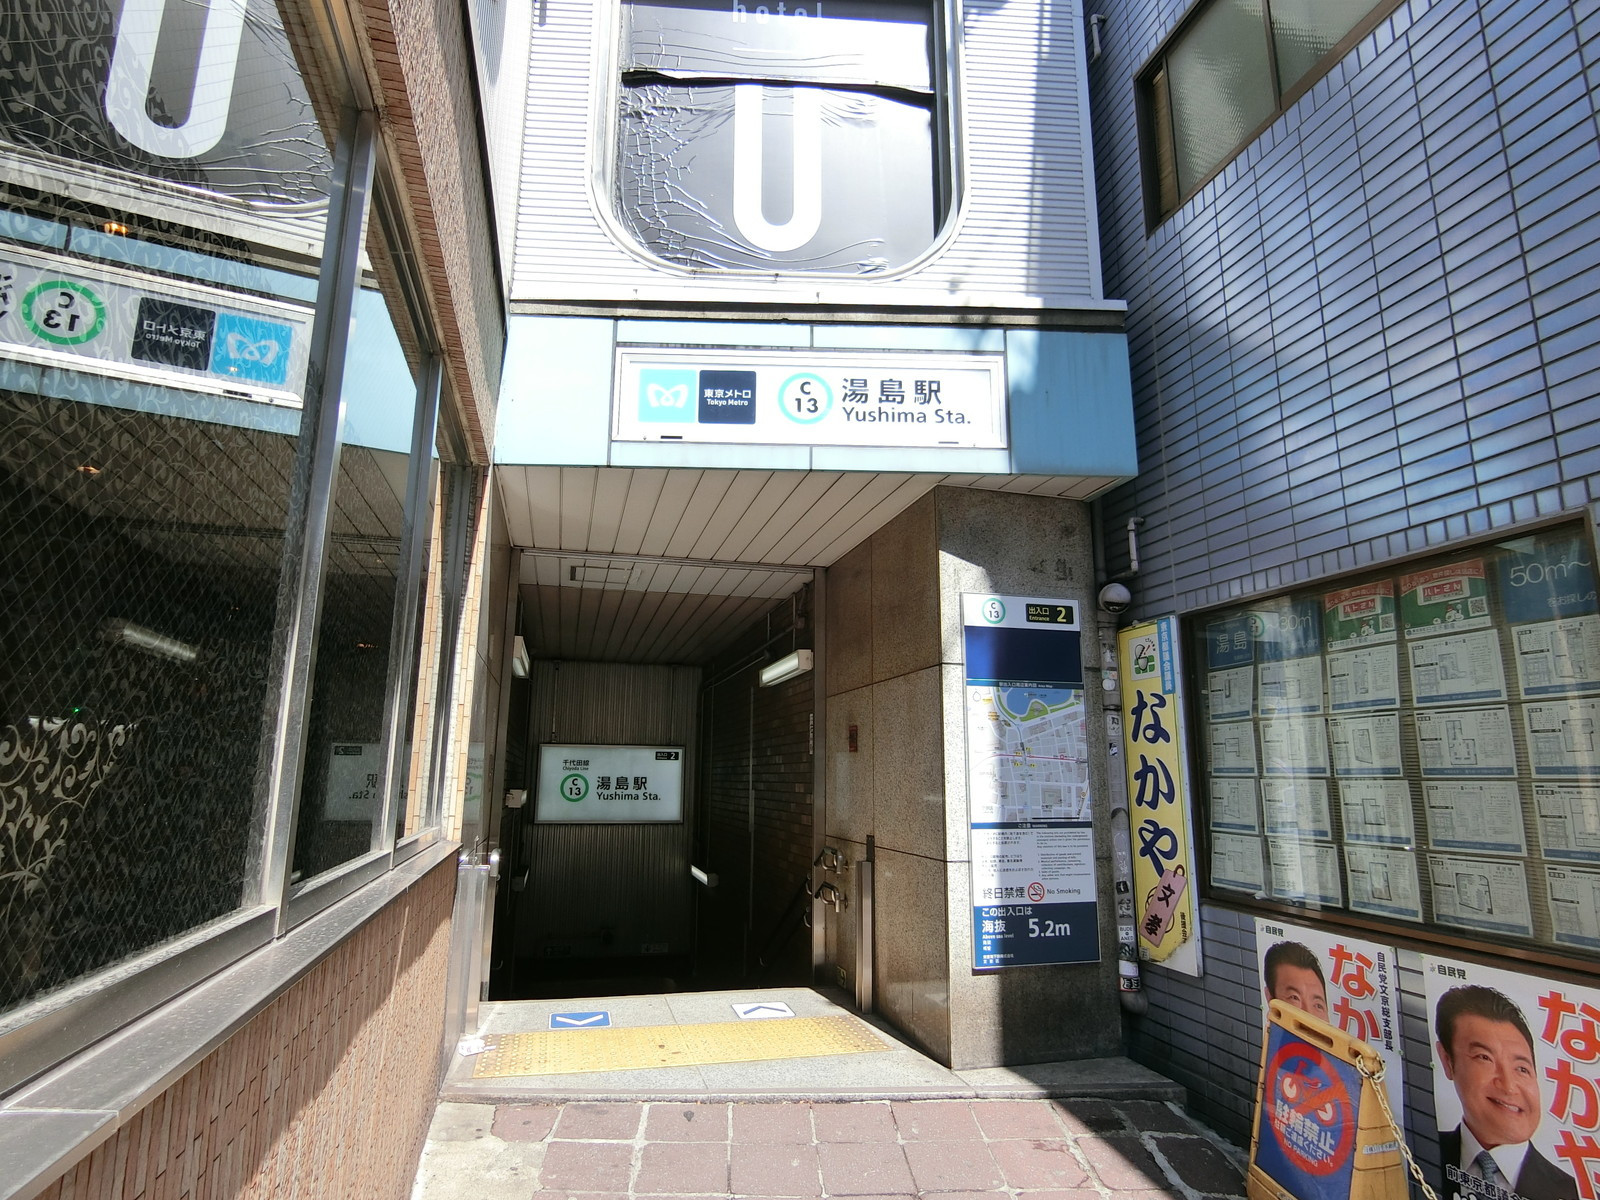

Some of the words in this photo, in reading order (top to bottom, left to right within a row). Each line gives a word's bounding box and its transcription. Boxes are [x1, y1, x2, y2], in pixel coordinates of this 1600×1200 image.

[733, 80, 822, 252] U
[704, 388, 751, 399] 東京メトロ
[799, 381, 811, 395] C
[842, 378, 942, 405] 湯島駅
[707, 398, 725, 407] Tokyo
[726, 398, 749, 407] Metro
[794, 396, 819, 414] 13
[842, 406, 927, 424] Yushima
[934, 408, 971, 425] Sta.
[988, 610, 1000, 619] 13
[1028, 606, 1049, 615] 出入口
[1056, 607, 1067, 622] 2
[1216, 631, 1247, 654] 湯島
[562, 759, 590, 767] 千代田線
[571, 778, 579, 786] C
[596, 776, 648, 791] 湯島駅
[1131, 689, 1179, 878] なかや
[568, 787, 582, 796] 13
[596, 791, 639, 801] Yushima
[642, 791, 661, 801] Sta.
[982, 886, 1025, 900] 終日禁煙
[1057, 887, 1081, 895] Smoking
[981, 906, 1033, 917] この出入口は
[981, 919, 1006, 933] 海抜
[1028, 917, 1071, 938] 5.2m
[1437, 964, 1466, 980] 自民党
